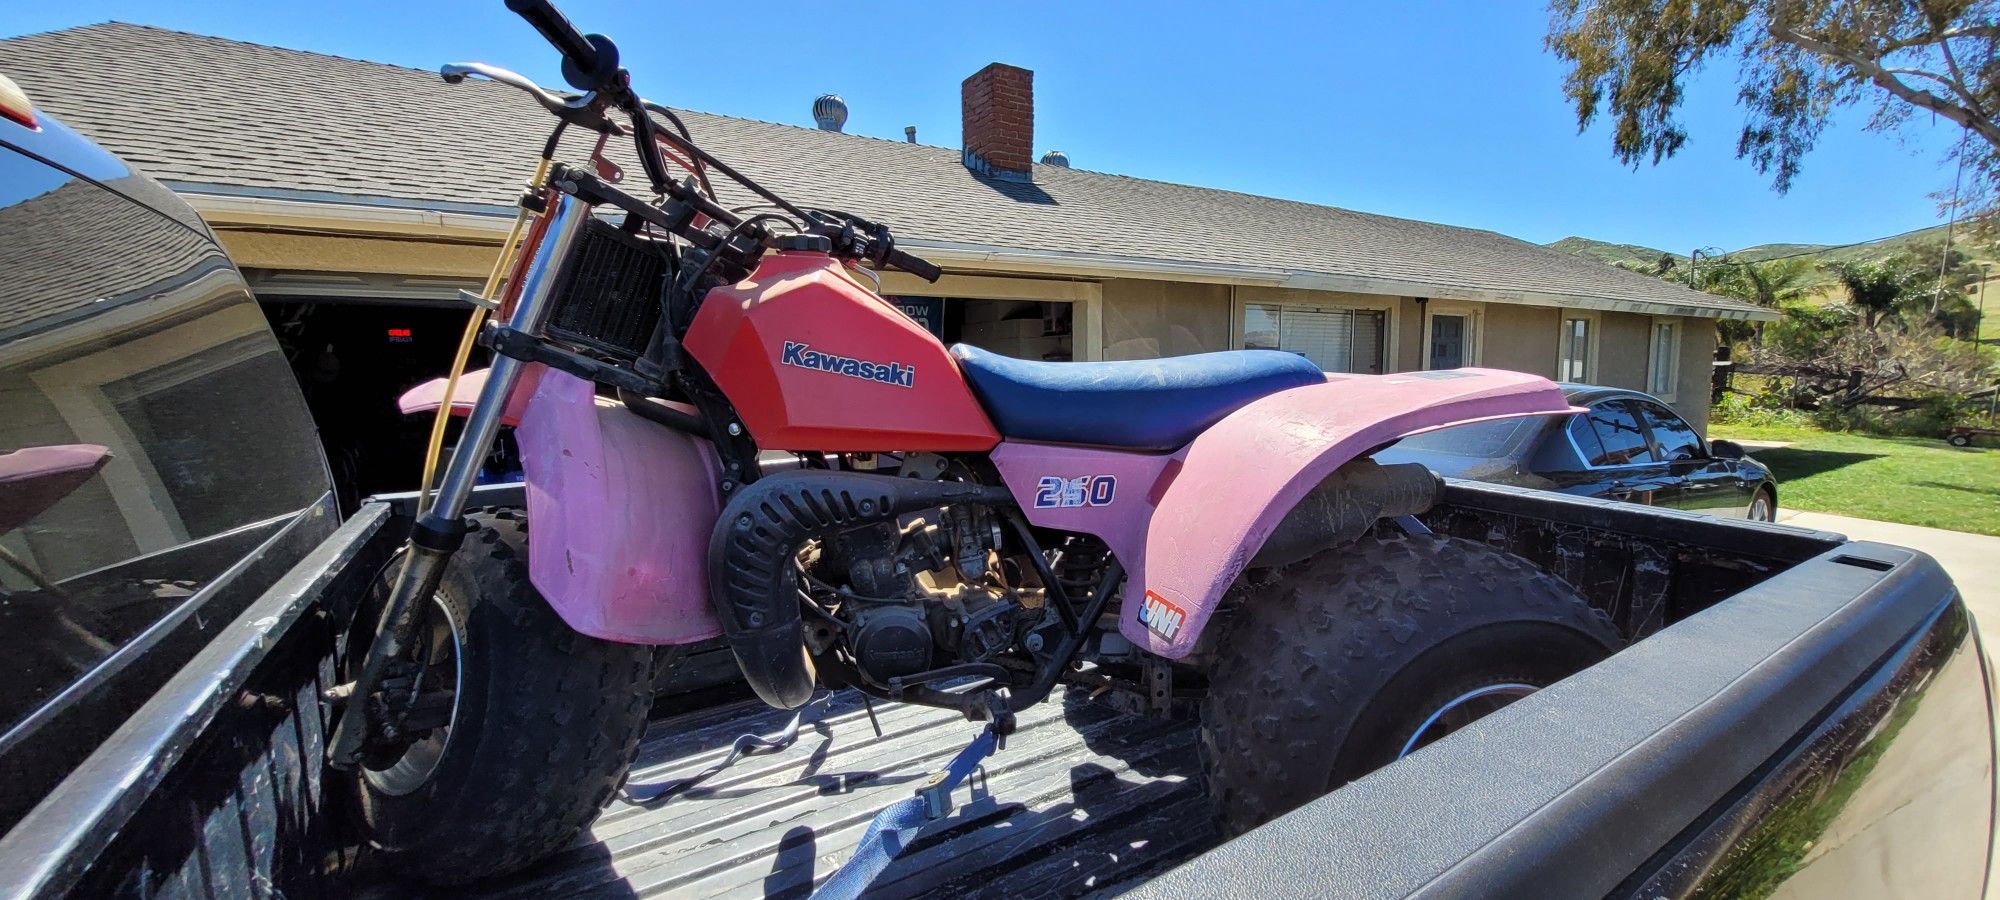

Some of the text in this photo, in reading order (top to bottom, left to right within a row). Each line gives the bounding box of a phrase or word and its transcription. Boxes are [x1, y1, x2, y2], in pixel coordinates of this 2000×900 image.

[781, 341, 915, 388] Kawasaki
[1034, 475, 1117, 508] 250
[1140, 594, 1182, 639] UNI
